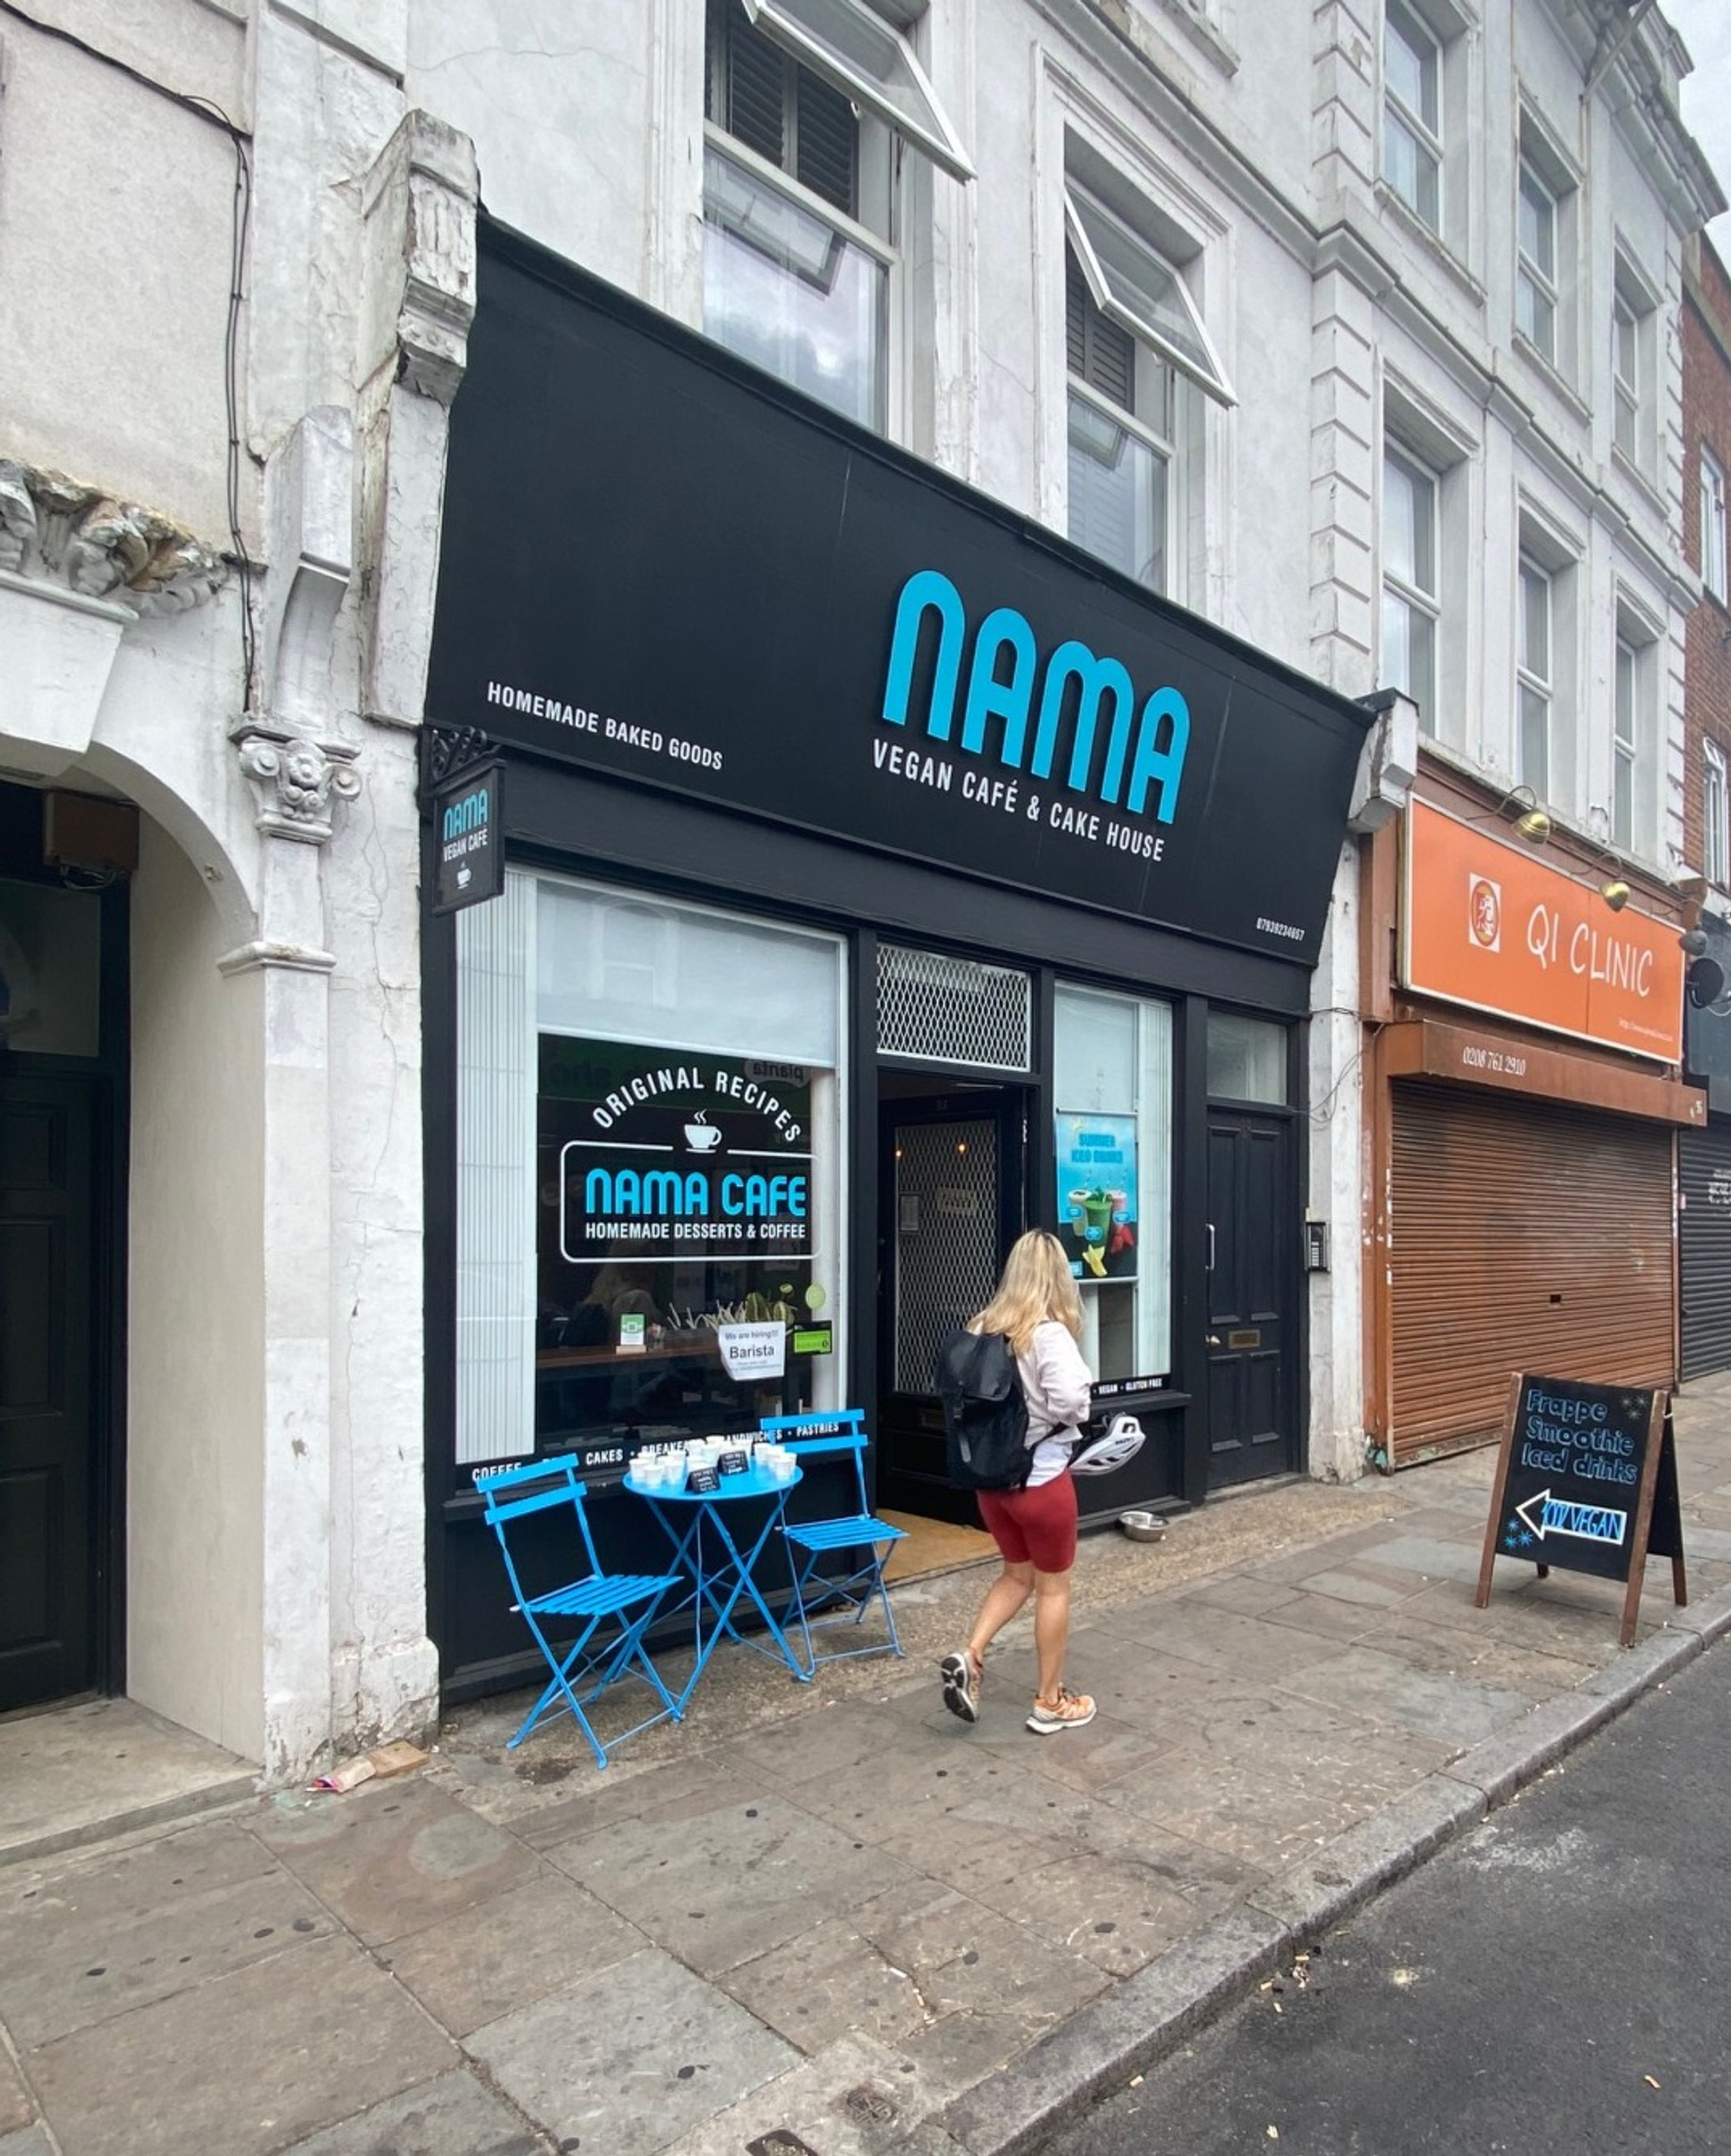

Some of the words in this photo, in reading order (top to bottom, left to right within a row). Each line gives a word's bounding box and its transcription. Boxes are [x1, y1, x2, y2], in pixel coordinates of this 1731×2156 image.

[882, 569, 1190, 824] NAMA
[487, 681, 599, 733] HOMEMADE
[605, 718, 663, 751] BAKED
[669, 738, 723, 770] GOODS
[444, 789, 489, 841] NAMA
[874, 738, 953, 791] VEGAN
[962, 771, 1019, 813] CAFÉ
[1026, 795, 1040, 821] &
[1050, 802, 1100, 841] CAKE
[1106, 822, 1165, 862] HOUSE
[443, 836, 467, 862] VEGAN
[1527, 904, 1559, 970] QI
[1570, 922, 1653, 997] CLINIC
[593, 1067, 704, 1129] ORIGINAL
[715, 1071, 800, 1142] RECIPES
[585, 1167, 708, 1216] NAMA
[721, 1174, 806, 1217] CAFE
[586, 1222, 670, 1239] HOMEMADE
[674, 1223, 742, 1239] DESSERTS
[746, 1223, 756, 1239] &
[760, 1223, 805, 1239] COFFEE
[730, 1345, 775, 1358] Barista
[1527, 1389, 1608, 1424] Frappe
[586, 1448, 624, 1466] CAKES
[796, 1422, 839, 1438] PASTRIES
[1526, 1415, 1635, 1456] Smoothie
[1521, 1442, 1569, 1473] Iced
[1573, 1453, 1638, 1485] drinks
[1570, 1505, 1620, 1539] VEGAN
